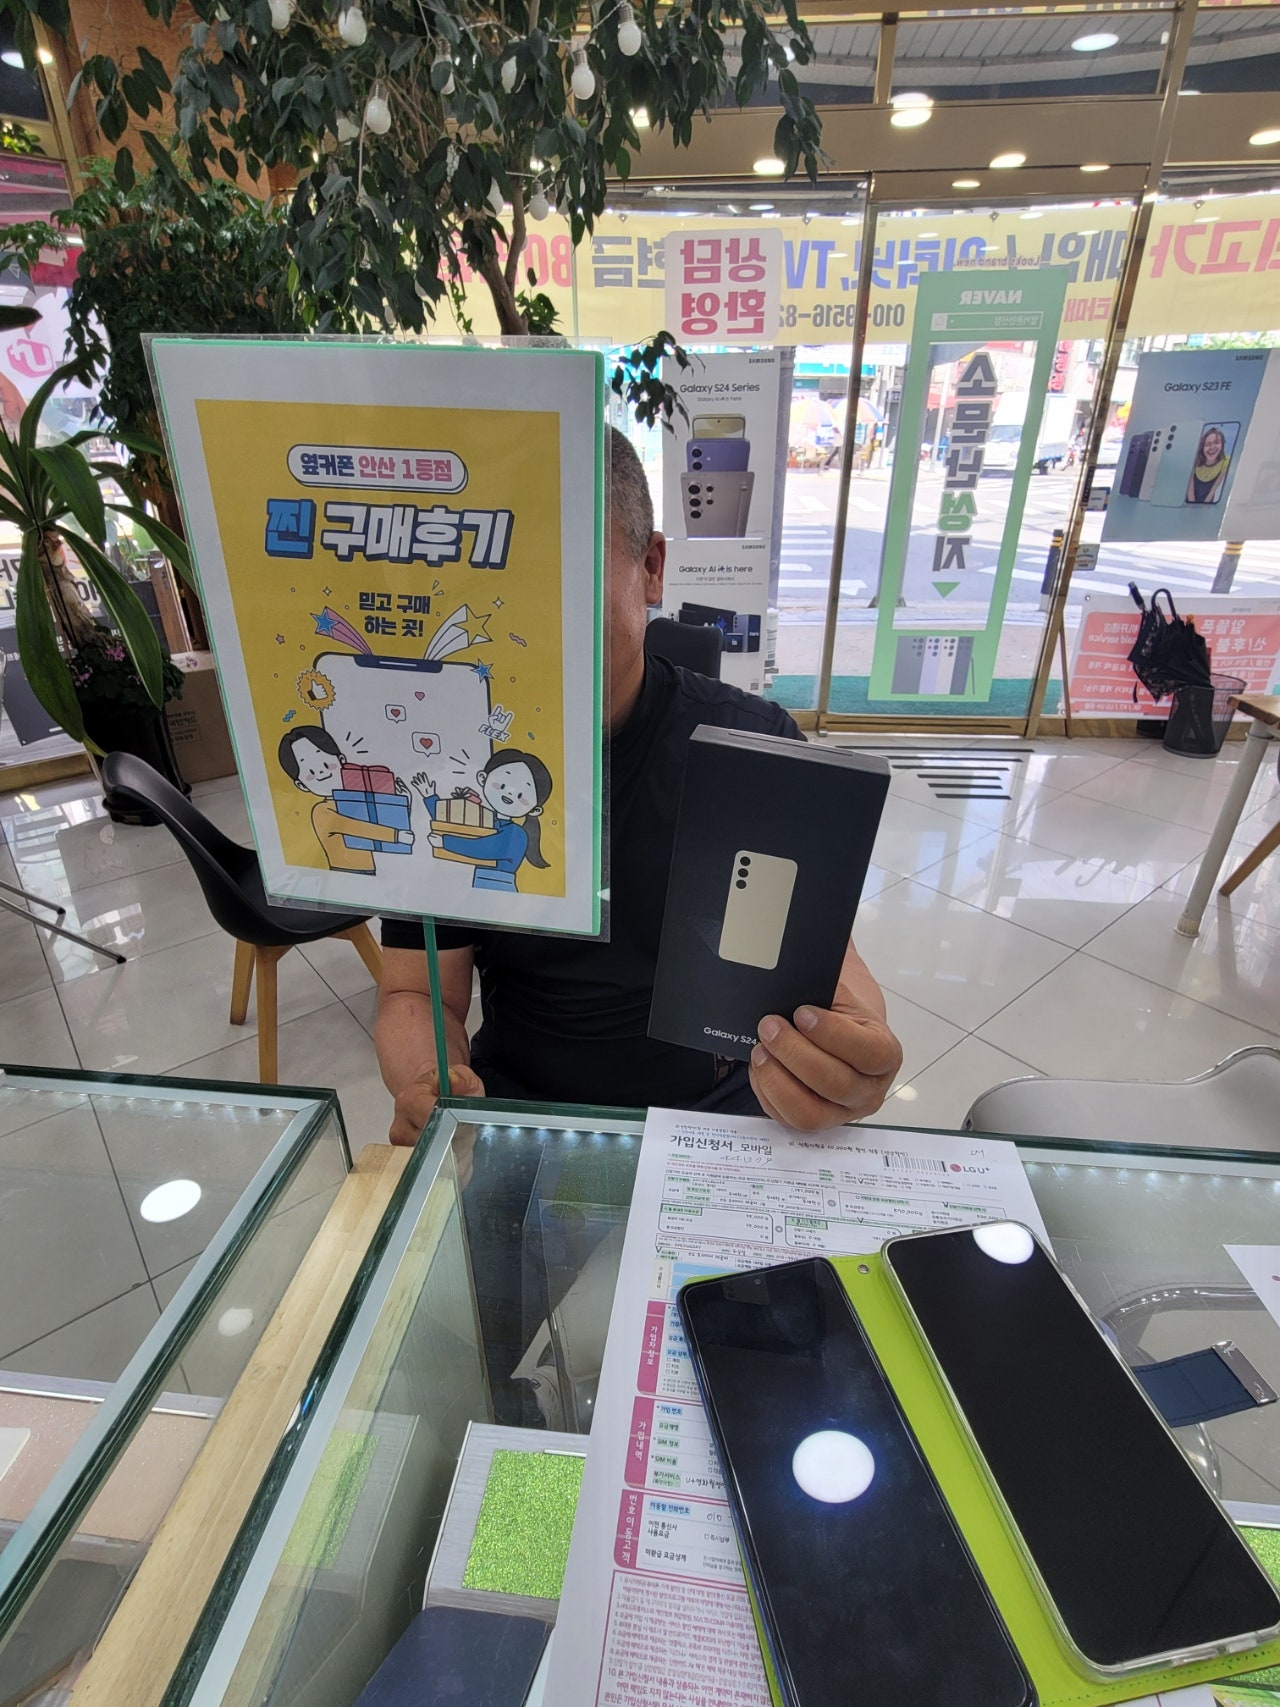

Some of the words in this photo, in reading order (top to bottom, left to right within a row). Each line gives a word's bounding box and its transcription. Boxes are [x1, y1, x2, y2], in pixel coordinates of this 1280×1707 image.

[680, 383, 712, 395] Galaxy
[714, 383, 730, 393] S24
[731, 382, 760, 393] Series
[1164, 380, 1200, 393] Galaxy
[1202, 380, 1221, 391] S23
[1222, 380, 1232, 391] FE
[300, 453, 355, 477] 옆커폰
[358, 455, 395, 480] 안산
[402, 458, 452, 482] 1등점
[265, 498, 316, 559] 찐
[320, 500, 514, 570] 구매후기
[679, 565, 706, 575] Galaxy
[726, 565, 732, 573] is
[733, 565, 753, 573] here
[359, 591, 392, 613] 믿고
[396, 594, 431, 615] 구매
[364, 615, 397, 636] 하는
[401, 618, 424, 637] 곳!
[479, 724, 510, 742] FLEX
[703, 1026, 739, 1043] Galaxy
[963, 1165, 976, 1174] LG
